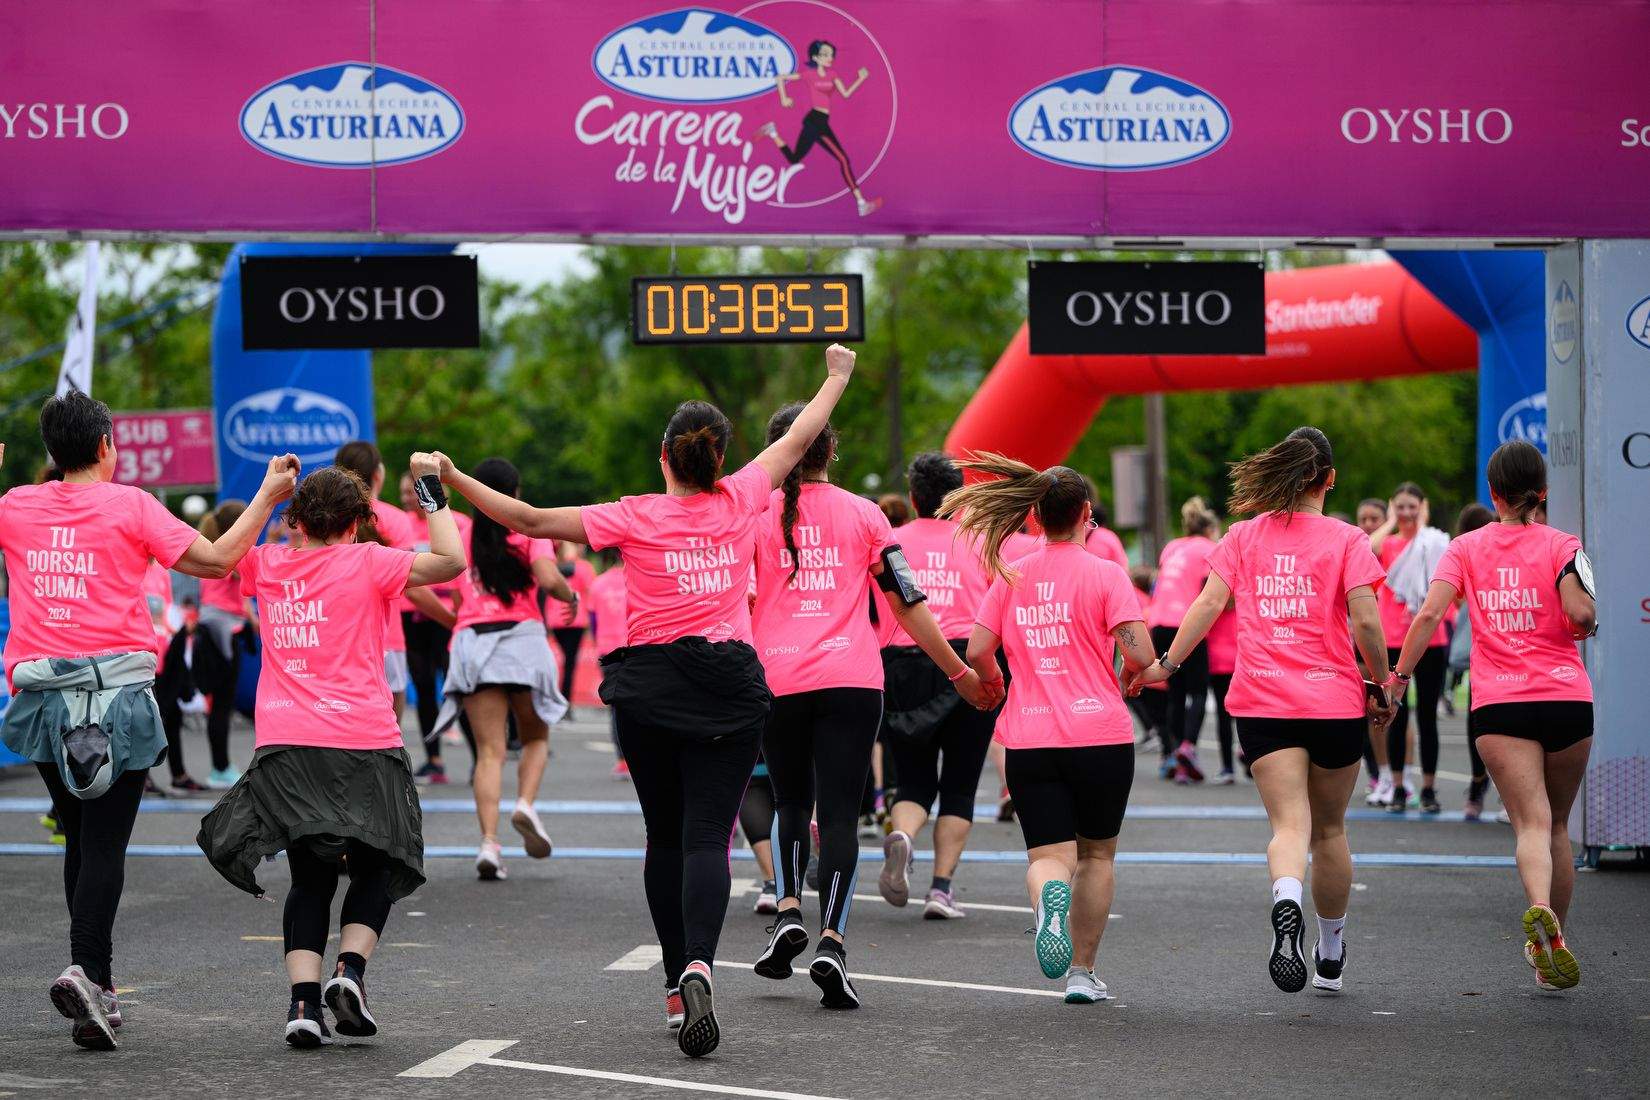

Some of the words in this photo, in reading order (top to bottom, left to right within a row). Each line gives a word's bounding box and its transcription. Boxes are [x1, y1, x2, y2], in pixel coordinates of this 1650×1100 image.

[610, 43, 780, 79] ASTURIANA
[291, 99, 361, 109] CENTRAL
[1059, 102, 1129, 112] CENTRAL
[1136, 102, 1207, 112] LECHERA
[258, 101, 446, 140] ASTURIANA
[574, 94, 743, 147] Carrera
[1026, 104, 1213, 142] ASTURIANA
[1340, 107, 1513, 145] OYSHO
[615, 147, 648, 183] de
[653, 147, 677, 183] la
[670, 141, 805, 224] Mujer
[279, 285, 446, 324] OYSHO
[647, 283, 850, 335] 00:38:53
[1066, 290, 1232, 327] OYSHO
[115, 418, 169, 446] SUB
[49, 526, 76, 549] TU
[798, 526, 821, 547] TU
[26, 550, 98, 575] DORSAL
[664, 542, 740, 573] DORSAL
[779, 546, 844, 569] DRSAL
[926, 551, 947, 569] TU
[1274, 554, 1296, 575] TU
[33, 575, 89, 599] SUMA
[677, 568, 734, 596] SUMA
[1497, 567, 1520, 588] TU
[924, 588, 955, 607] UMA
[1035, 581, 1056, 603] TU
[1476, 587, 1543, 611] DORSAL
[48, 607, 71, 620] 2024
[267, 599, 329, 625] DORSAL
[800, 599, 822, 611] 2024
[1015, 602, 1072, 626] DORSAL
[1259, 598, 1309, 619] SUMA
[1272, 626, 1296, 639] 2024
[1486, 611, 1536, 633] SUMA
[273, 625, 321, 650] SUMA
[1025, 625, 1071, 649] SUMA
[286, 658, 308, 671] 2024
